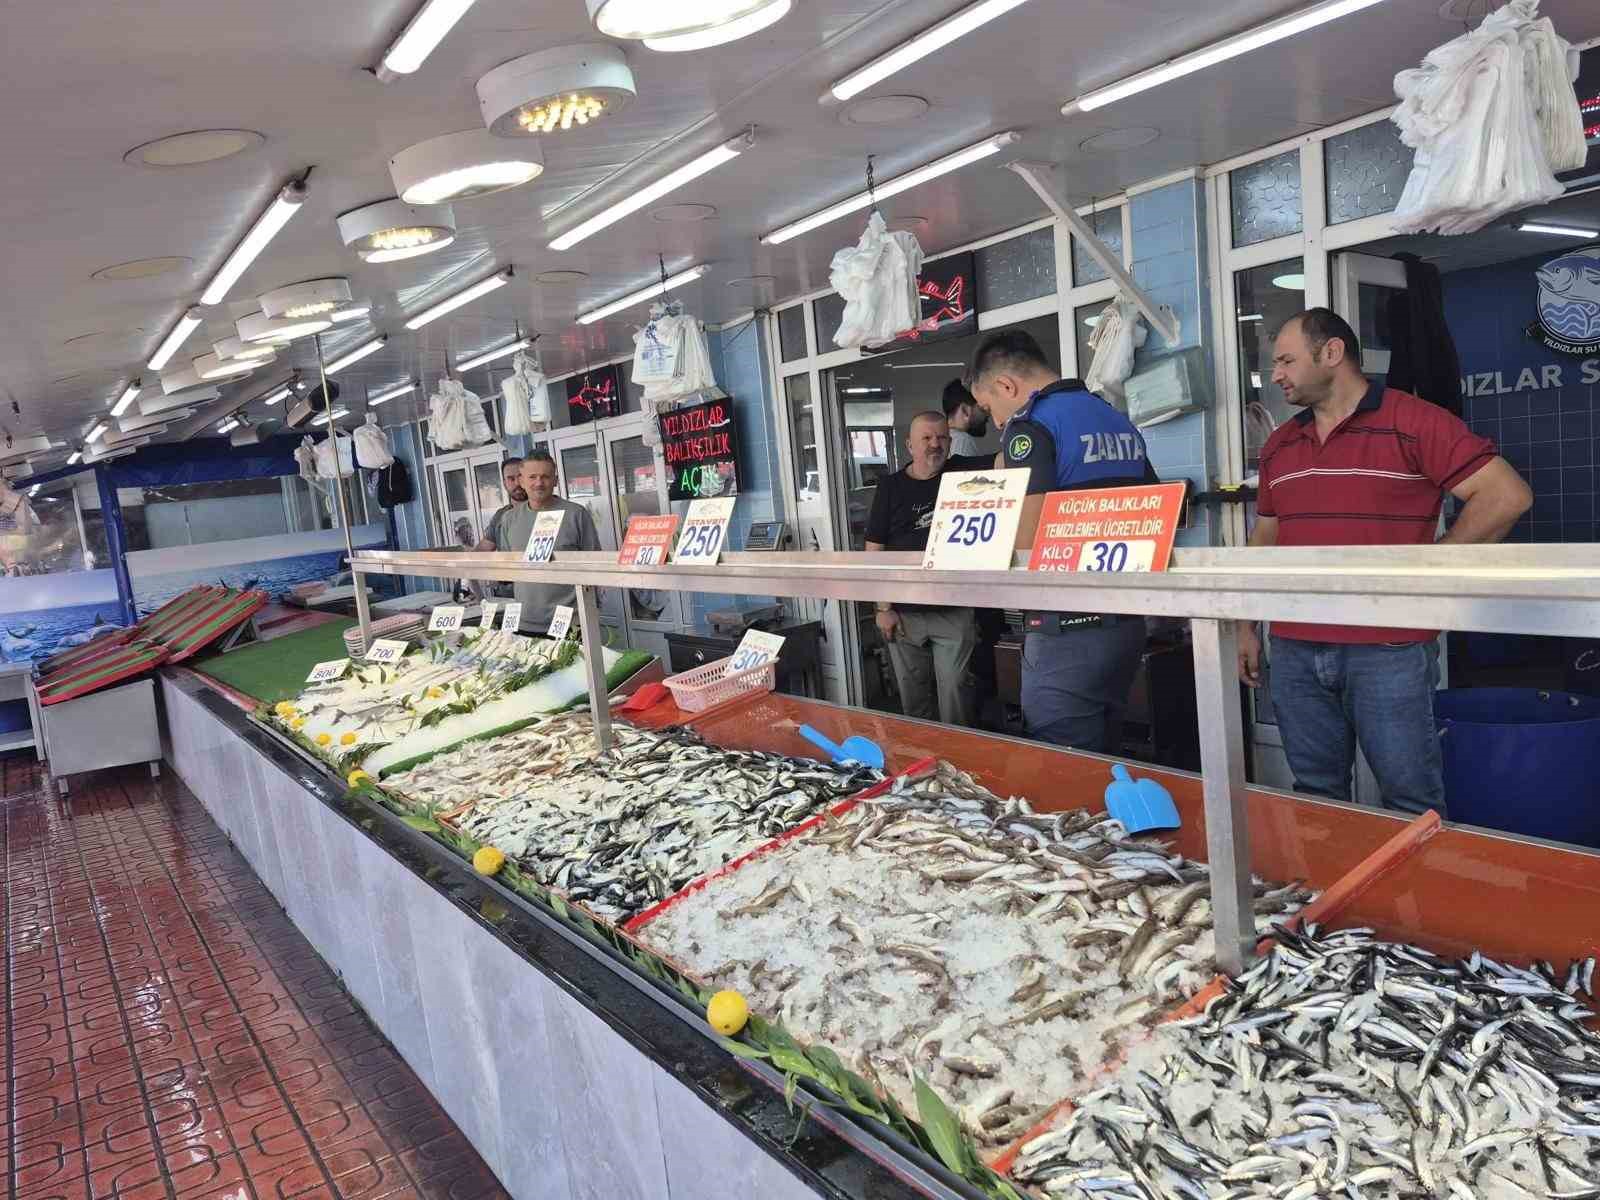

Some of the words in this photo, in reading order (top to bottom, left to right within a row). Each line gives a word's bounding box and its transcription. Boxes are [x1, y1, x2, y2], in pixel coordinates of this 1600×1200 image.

[1462, 365, 1563, 397] IZLAR
[663, 405, 724, 437] YILDIZLAR
[666, 432, 731, 463] BALIKÇILIK
[1080, 433, 1146, 464] ZABITA
[681, 463, 723, 497] AÇIK
[940, 497, 1017, 510] MEZGİT
[1057, 496, 1097, 516] KÜÇÜK
[1098, 494, 1163, 513] BALIKLARI
[679, 524, 721, 557] 250
[946, 511, 996, 546] 250
[528, 536, 554, 561] 350
[636, 547, 654, 565] 30
[1041, 543, 1074, 560] KİLO
[1086, 541, 1128, 572] 30
[435, 615, 456, 628] 600
[1060, 615, 1101, 626] ZABITA
[373, 648, 394, 659] 700
